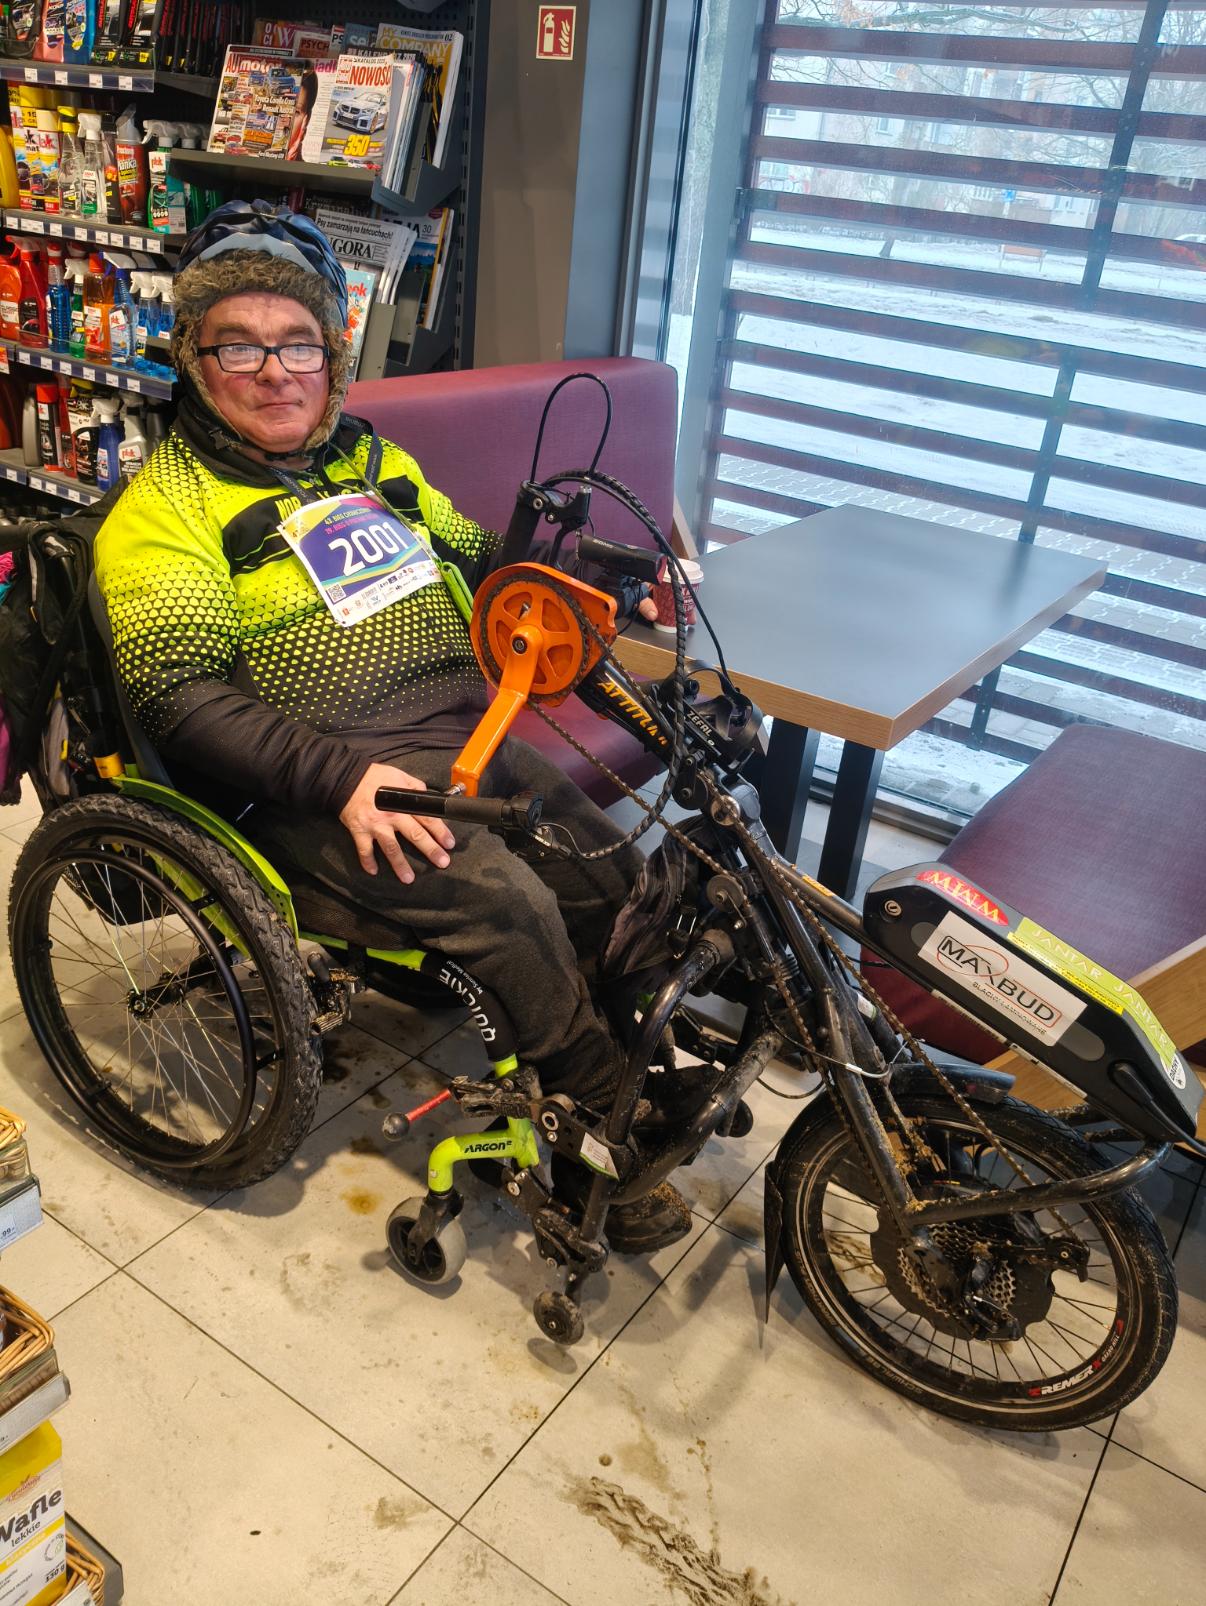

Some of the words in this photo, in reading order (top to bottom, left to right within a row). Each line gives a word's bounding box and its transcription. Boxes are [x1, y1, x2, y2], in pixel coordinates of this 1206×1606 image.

[377, 36, 453, 57] COMPANY
[344, 134, 372, 157] 350
[421, 223, 432, 234] 30
[327, 520, 410, 578] 2001
[686, 710, 715, 737] ZEFAL
[1031, 929, 1104, 980] JANTAR
[938, 938, 1056, 1023] MAXBUD
[439, 968, 497, 1042] QUICKIE
[11, 1521, 41, 1548] lekkie
